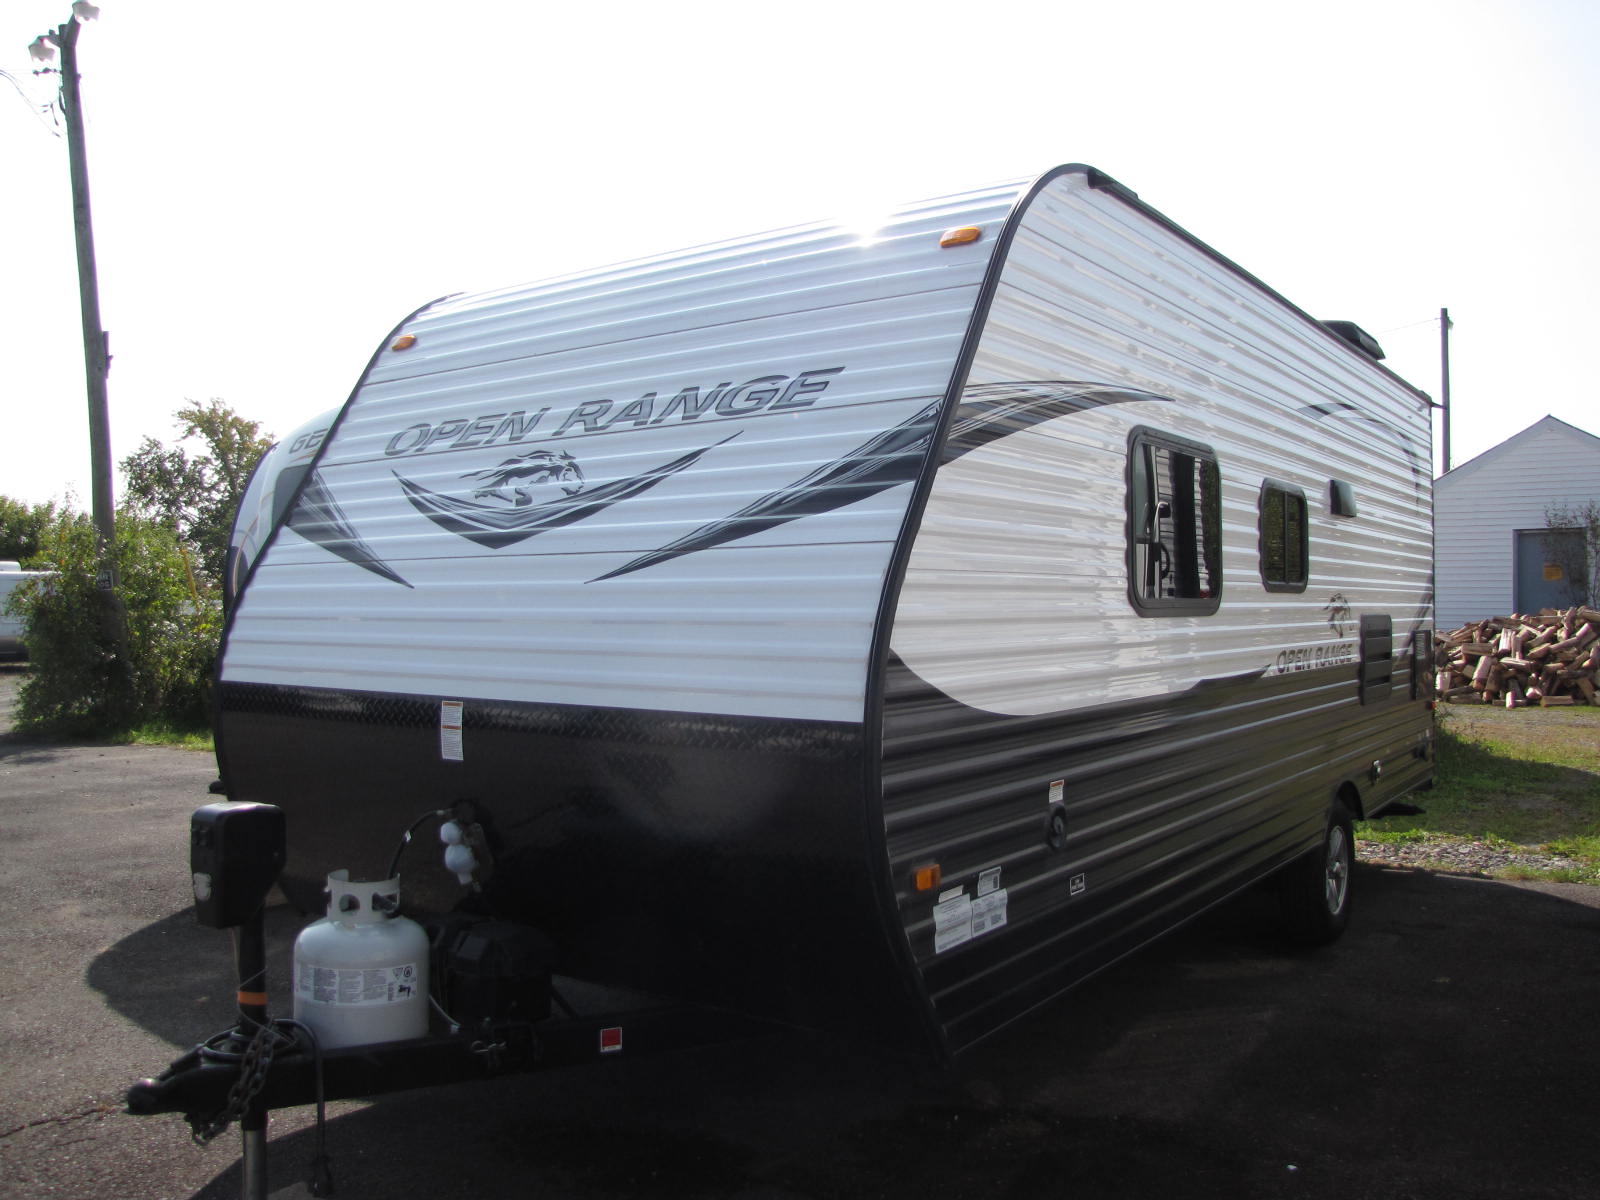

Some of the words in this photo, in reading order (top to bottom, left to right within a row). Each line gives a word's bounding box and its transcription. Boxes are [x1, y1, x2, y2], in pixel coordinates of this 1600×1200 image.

[384, 406, 552, 456] OPEN
[552, 366, 845, 436] RANGE
[1276, 648, 1313, 673] OPEN
[1315, 643, 1353, 668] RANGE
